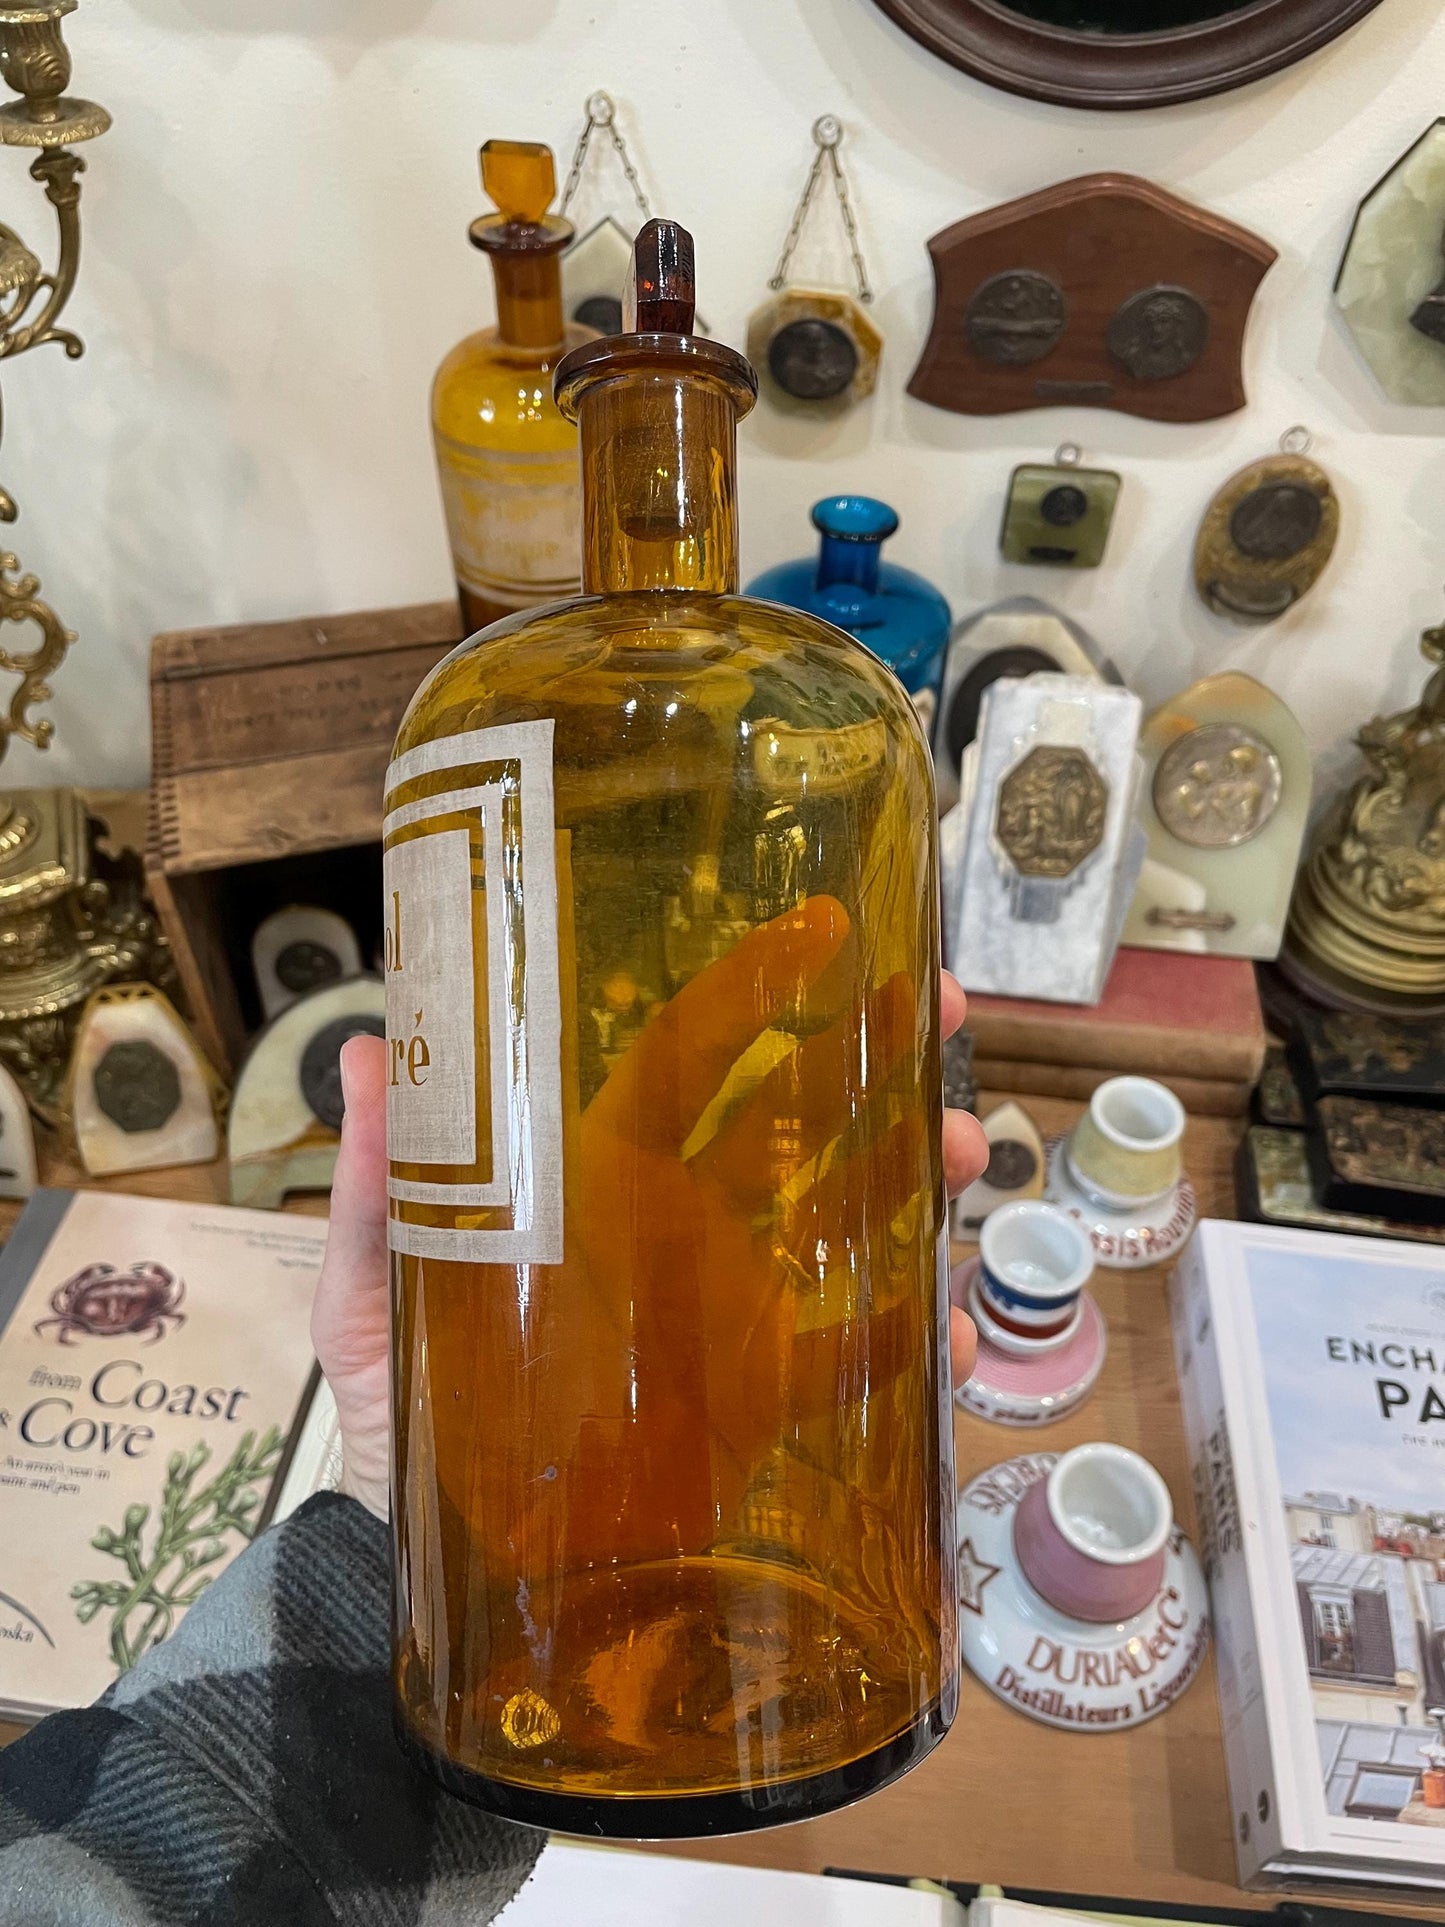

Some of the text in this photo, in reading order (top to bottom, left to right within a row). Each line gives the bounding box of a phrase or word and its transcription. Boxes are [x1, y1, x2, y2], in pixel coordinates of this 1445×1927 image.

[1326, 1334, 1445, 1374] ENCH
[29, 1359, 249, 1423] from Coast
[1376, 1378, 1445, 1424] PA
[20, 1397, 154, 1458] Cove
[996, 1664, 1133, 1724] Distillateurs
